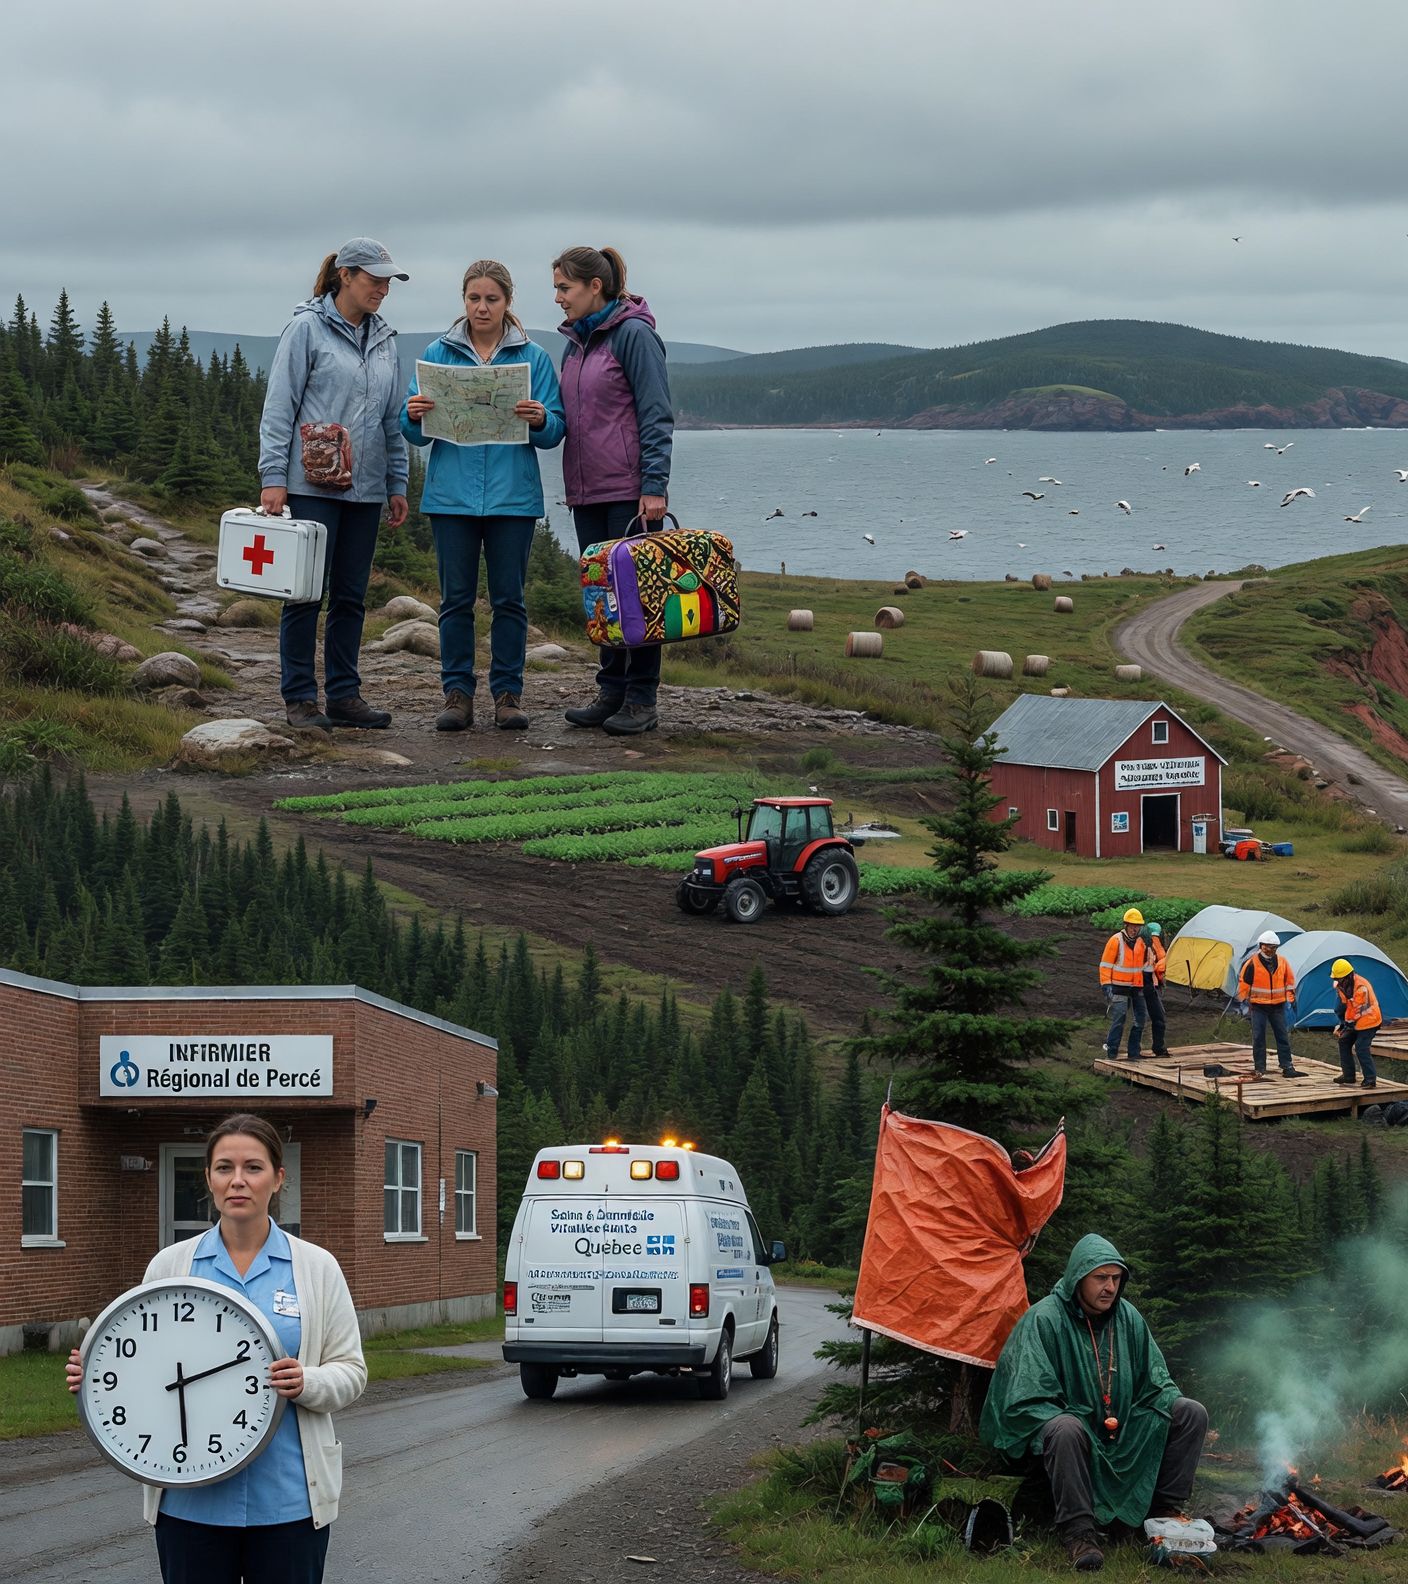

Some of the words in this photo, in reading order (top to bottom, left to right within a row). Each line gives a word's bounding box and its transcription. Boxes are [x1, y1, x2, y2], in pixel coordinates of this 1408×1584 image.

[169, 1043, 271, 1062] INFIRMIER
[146, 1068, 230, 1092] Régional
[236, 1068, 260, 1088] de
[266, 1068, 321, 1088] Percé
[173, 1302, 195, 1322] 12
[141, 1313, 158, 1332] 11
[215, 1313, 222, 1333] 1
[115, 1337, 137, 1358] 10
[236, 1340, 251, 1360] 2
[103, 1371, 118, 1391] 9
[245, 1375, 259, 1395] 3
[112, 1406, 127, 1426] 8
[232, 1409, 248, 1429] 4
[138, 1434, 152, 1454] 7
[172, 1443, 187, 1463] 6
[207, 1433, 223, 1454] 5
